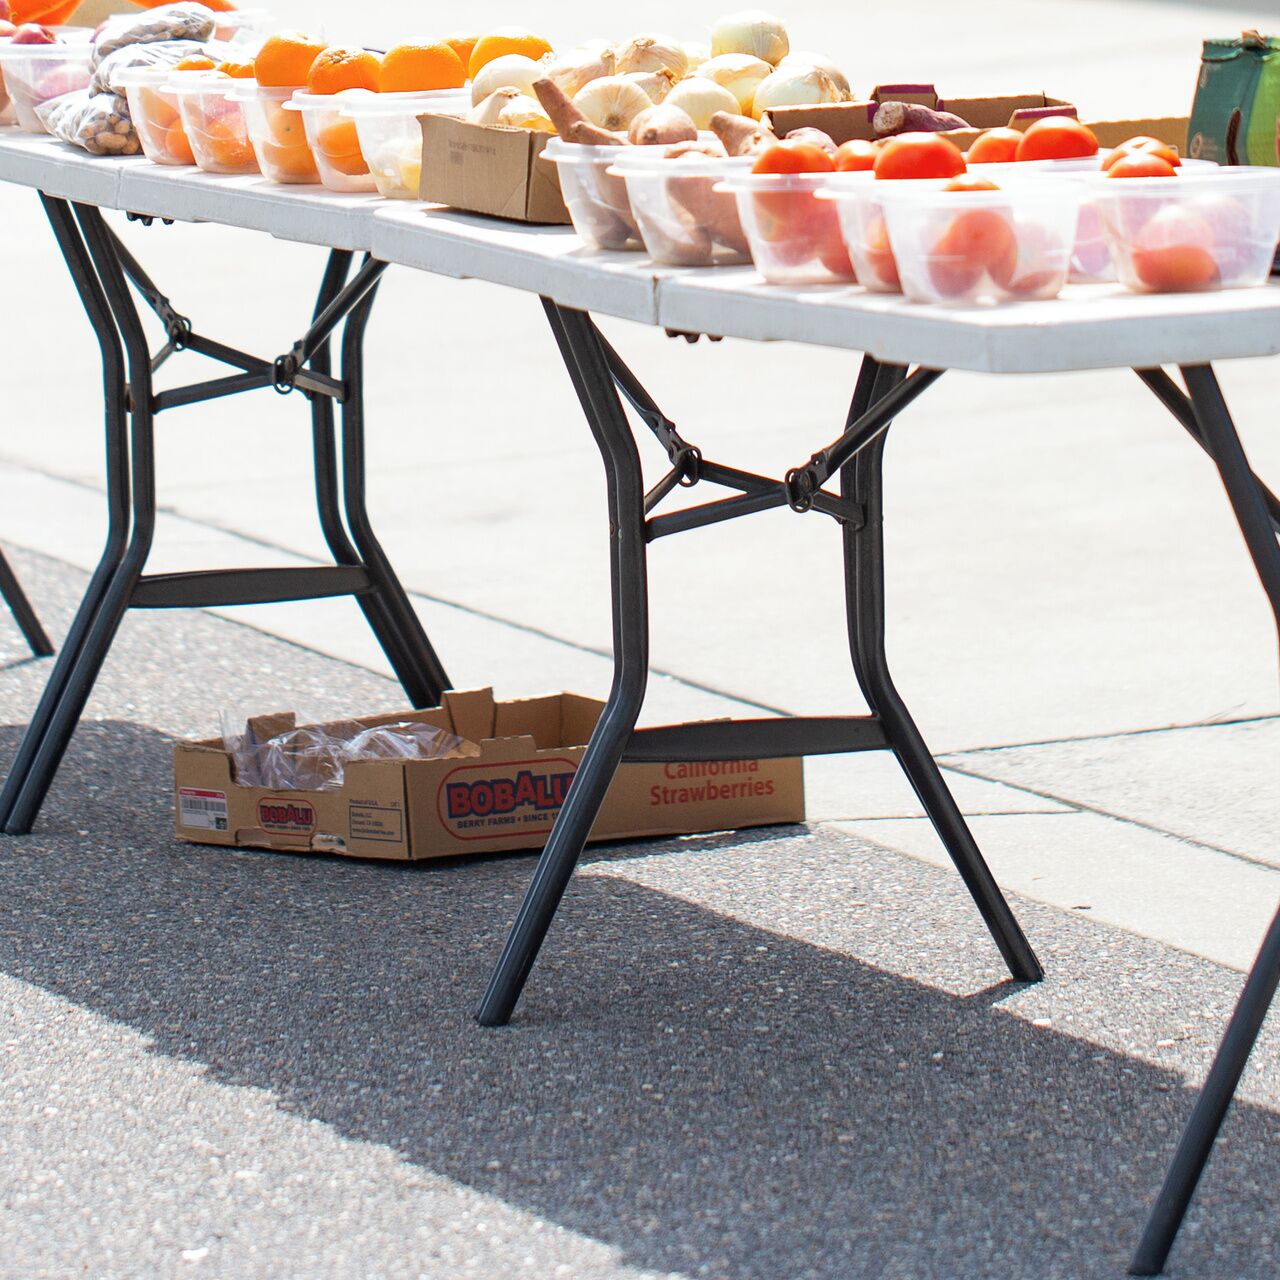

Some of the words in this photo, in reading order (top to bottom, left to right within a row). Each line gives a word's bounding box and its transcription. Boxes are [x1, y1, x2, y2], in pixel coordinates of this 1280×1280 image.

[664, 757, 759, 780] California
[650, 777, 775, 806] Strawberries
[260, 804, 313, 826] BOBALU
[457, 819, 485, 829] BERRY
[487, 816, 516, 826] FARMS
[523, 813, 548, 822] SINCE
